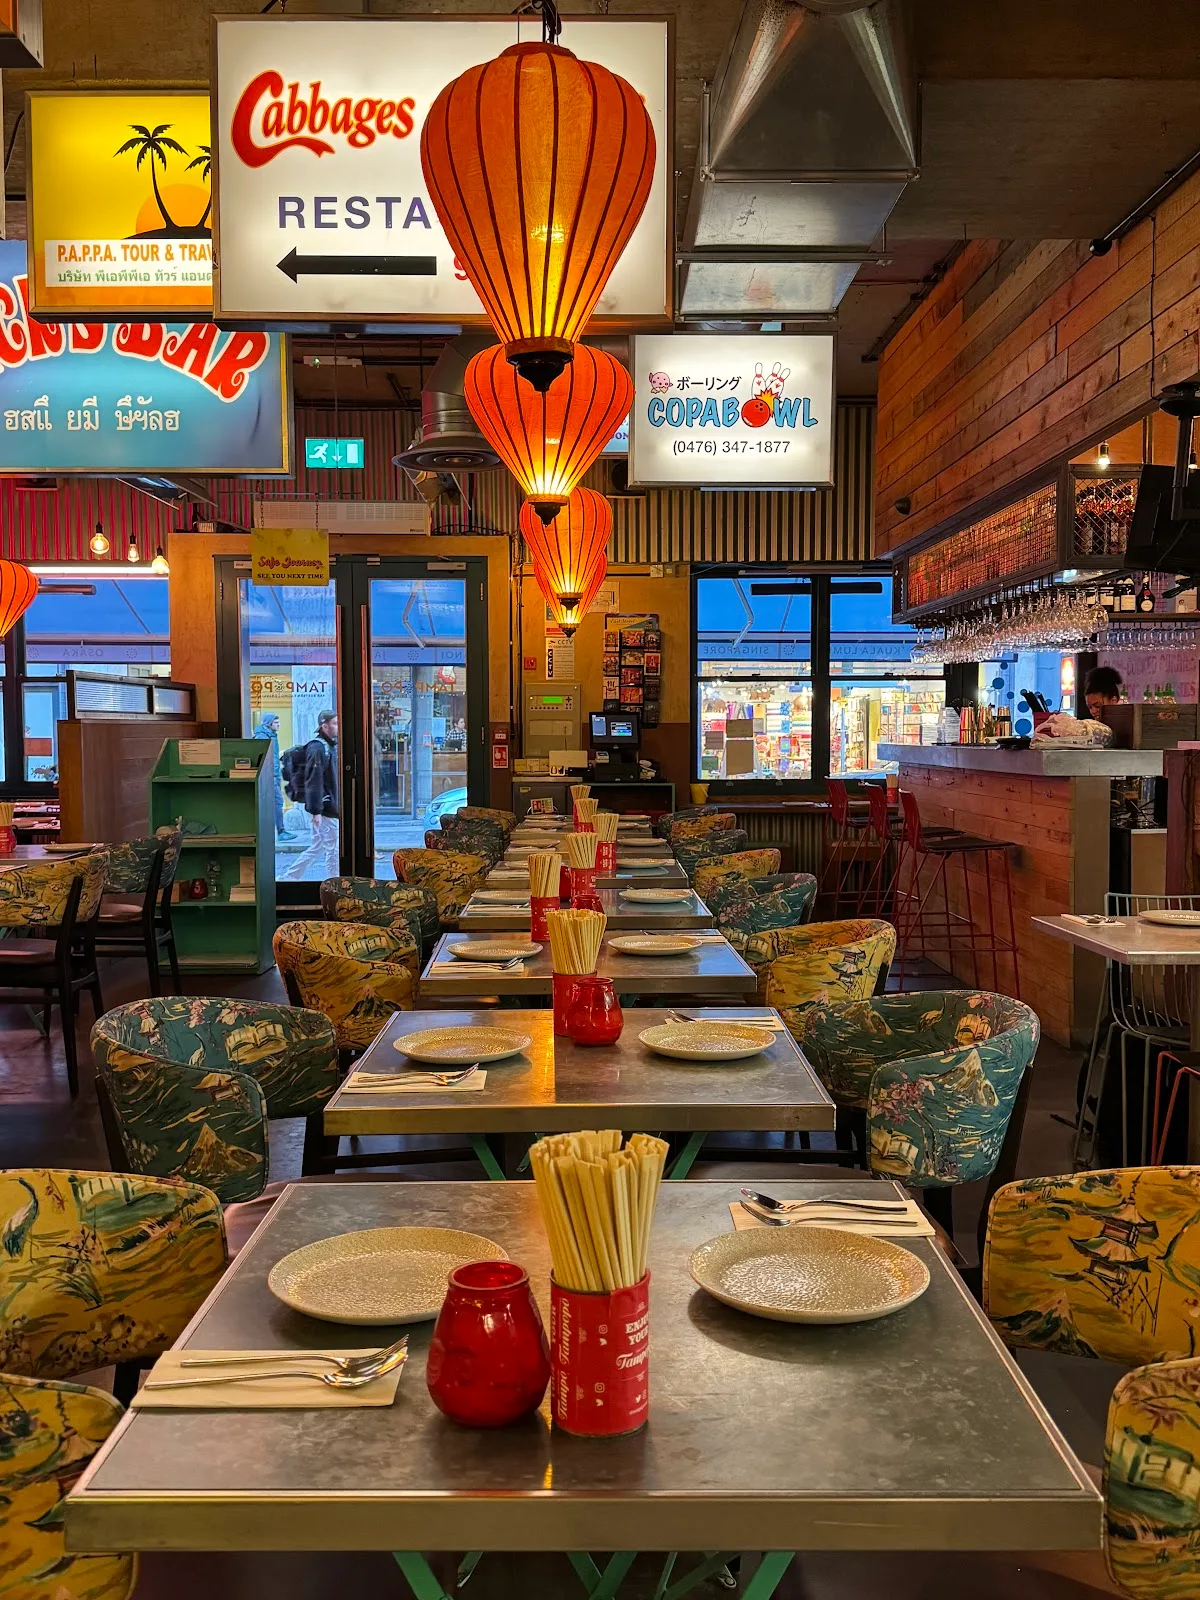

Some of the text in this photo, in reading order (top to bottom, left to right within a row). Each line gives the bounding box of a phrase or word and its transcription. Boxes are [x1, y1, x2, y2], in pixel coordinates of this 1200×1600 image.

[231, 69, 416, 169] Cabbages
[278, 195, 432, 229] RESTA
[57, 244, 117, 262] P.A.P.P.A.
[121, 243, 161, 261] TOUR
[165, 243, 175, 261] &
[58, 269, 91, 282] บริษัท
[155, 266, 178, 282] ทัวร์
[676, 376, 742, 392] ボーリング
[673, 440, 791, 455] (0476) 347-1877
[258, 556, 281, 570] Safe
[558, 1297, 572, 1366] Tampopo
